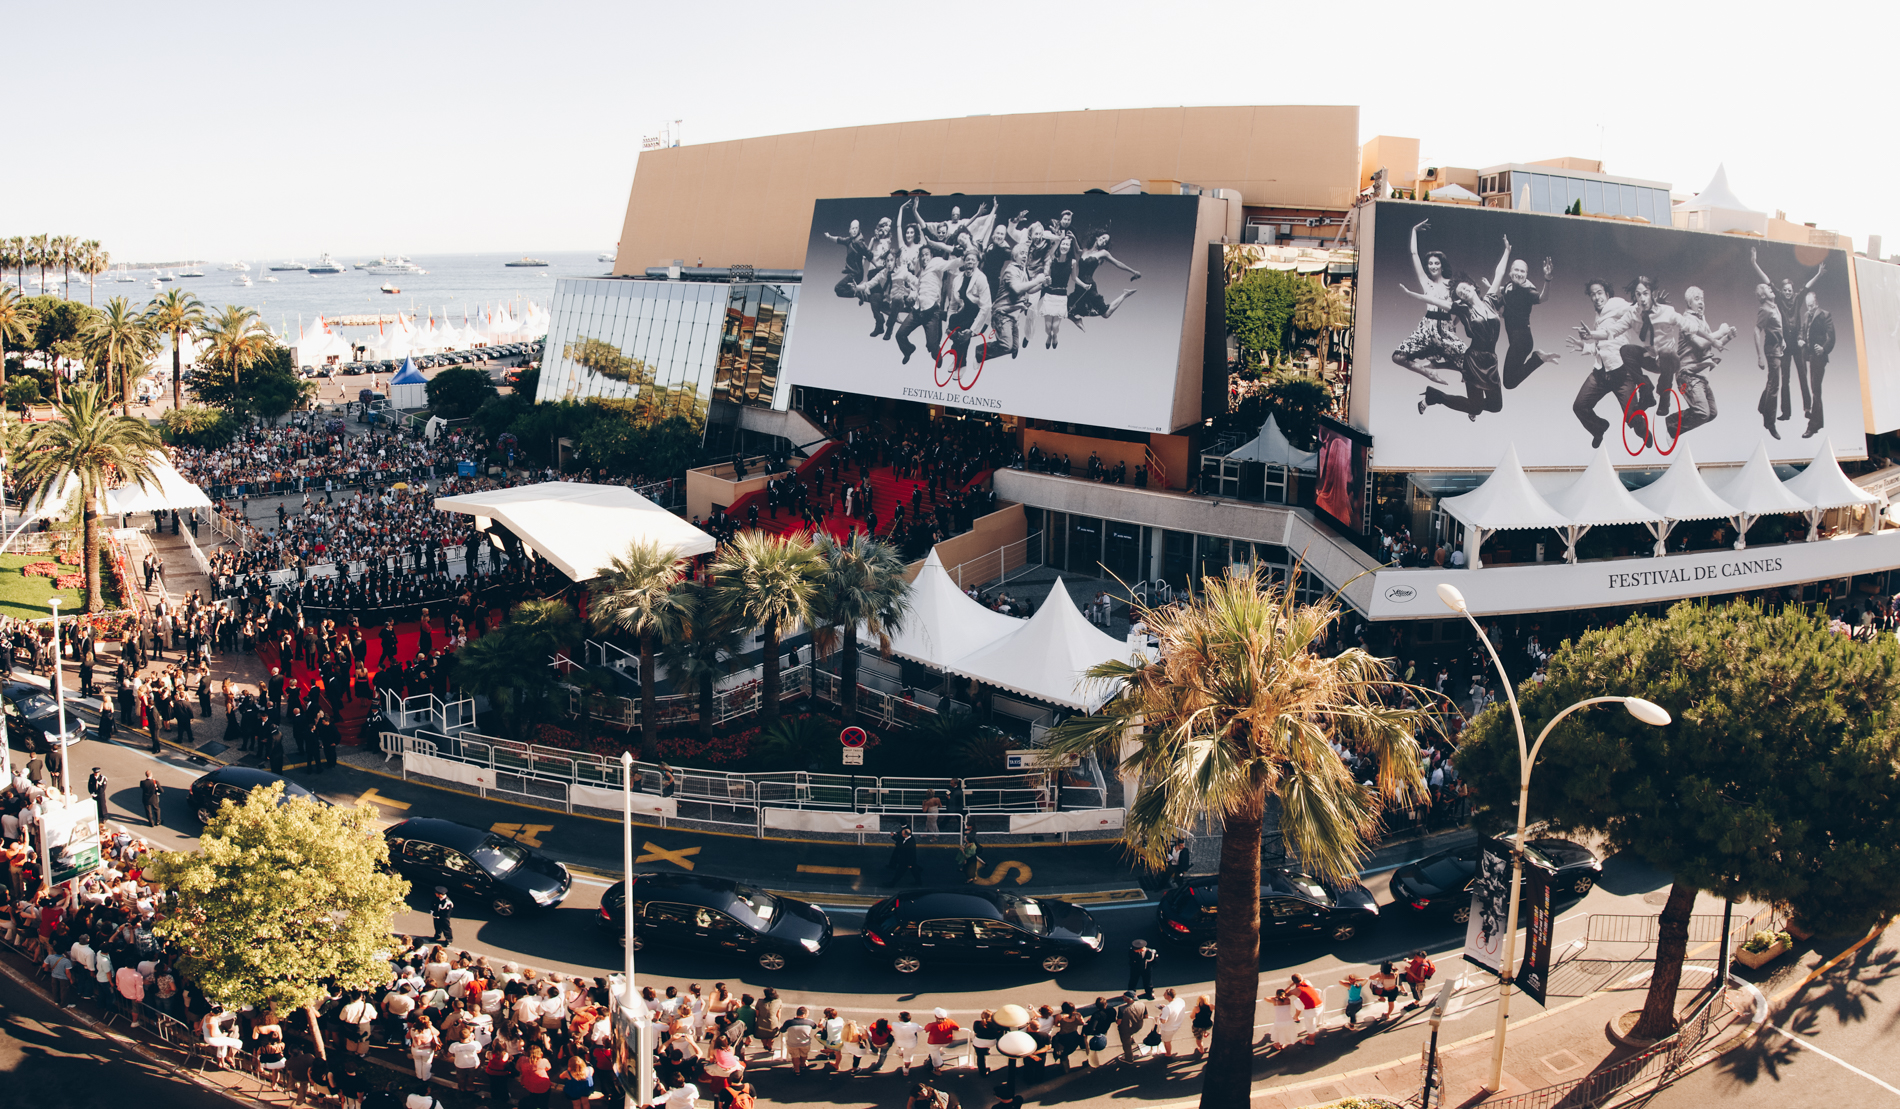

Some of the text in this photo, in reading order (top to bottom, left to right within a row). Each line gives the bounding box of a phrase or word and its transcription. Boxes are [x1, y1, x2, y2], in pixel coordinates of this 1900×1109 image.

[902, 387, 1002, 409] FESTIVAL DE CANNES
[1608, 557, 1783, 588] FESTIVAL DE CANNES
